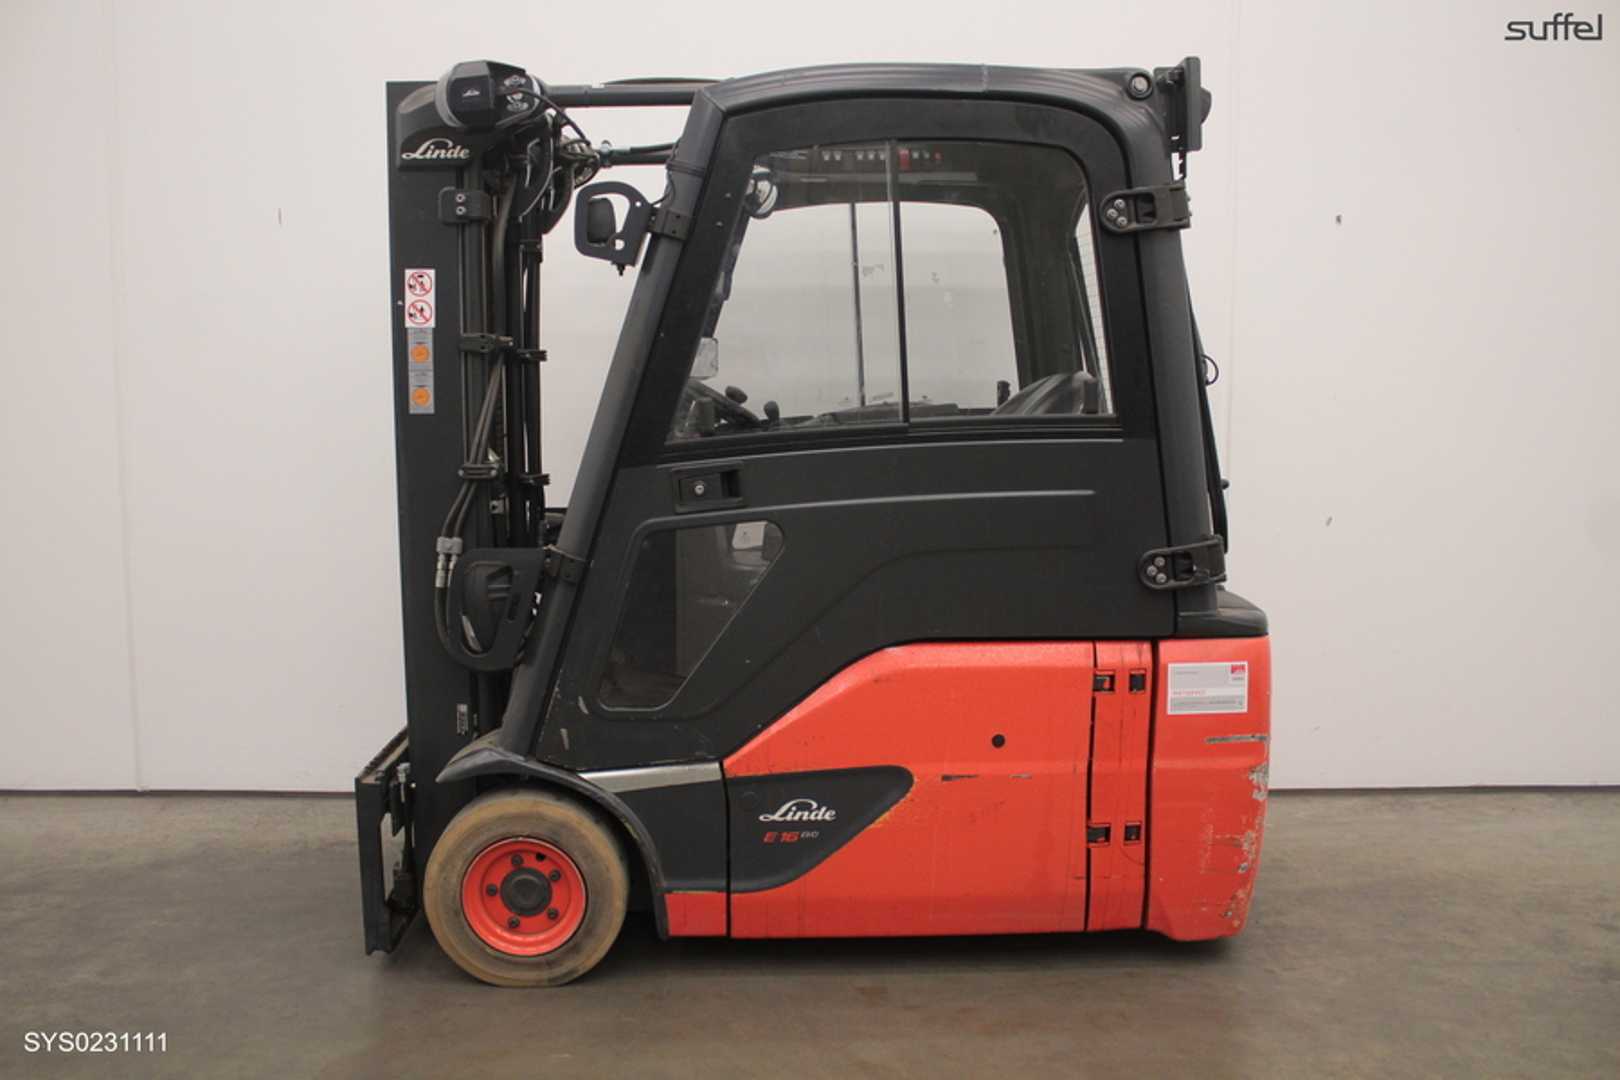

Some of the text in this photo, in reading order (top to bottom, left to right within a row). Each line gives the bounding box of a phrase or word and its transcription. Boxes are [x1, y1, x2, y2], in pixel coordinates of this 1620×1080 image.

[401, 137, 470, 159] Linde
[758, 798, 836, 821] Linde
[763, 831, 778, 843] E
[781, 831, 800, 843] 16
